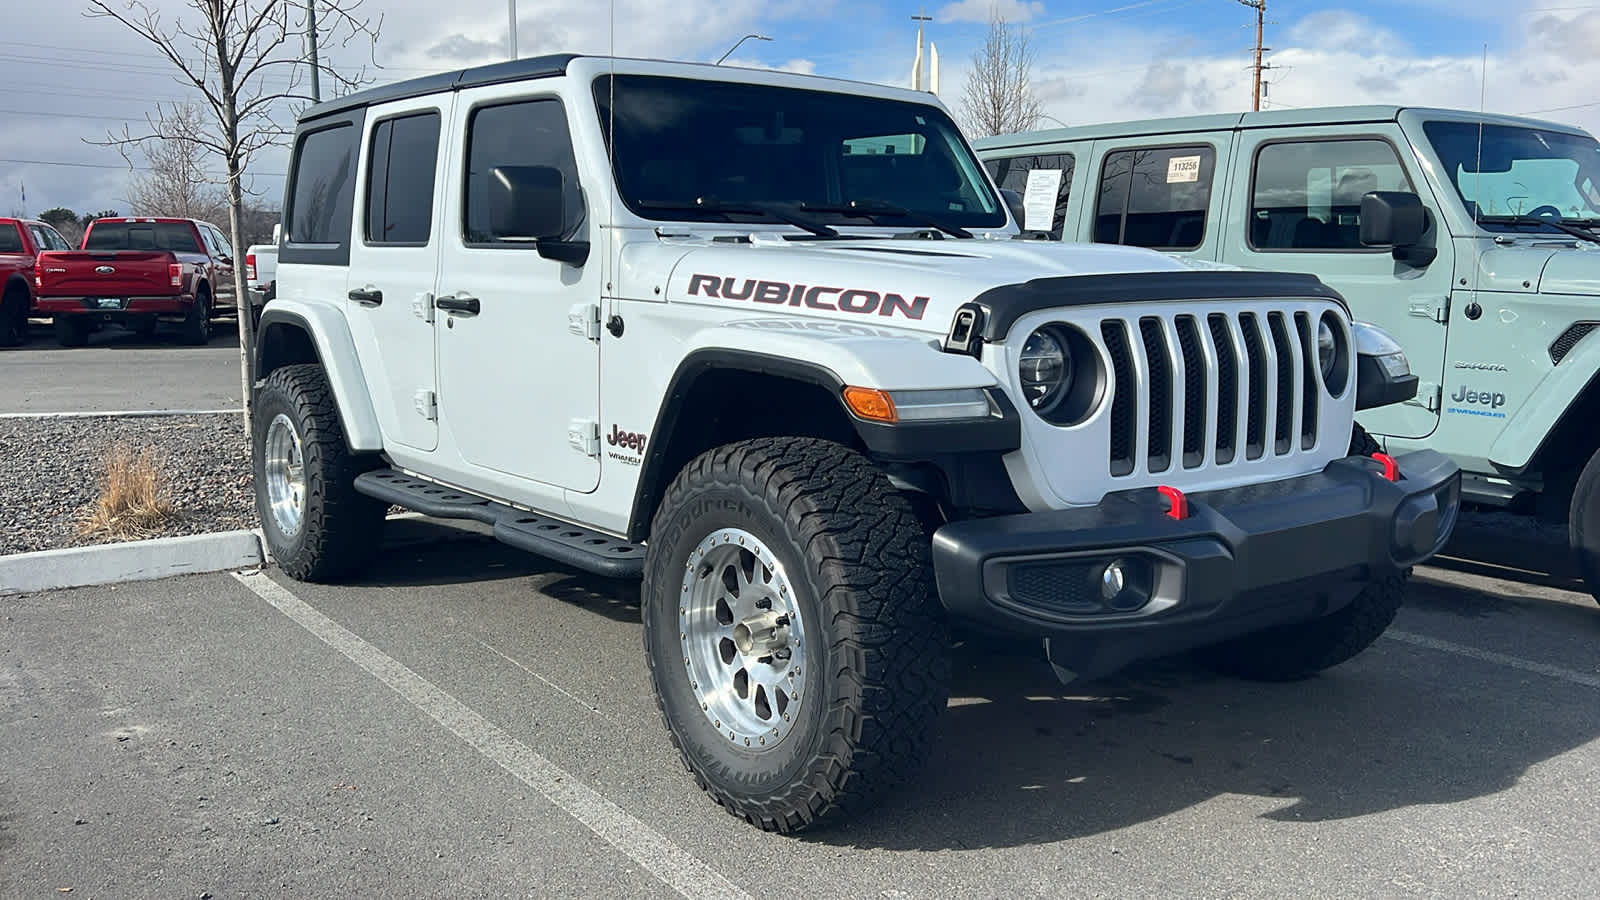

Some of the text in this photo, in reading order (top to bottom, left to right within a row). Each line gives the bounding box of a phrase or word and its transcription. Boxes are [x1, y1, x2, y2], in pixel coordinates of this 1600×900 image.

[1174, 161, 1198, 171] 113256
[687, 273, 931, 320] RUBICON
[1454, 360, 1508, 372] SAHARA
[1451, 384, 1506, 409] Jeep
[607, 423, 647, 455] Jeep
[608, 451, 641, 464] WRANGL
